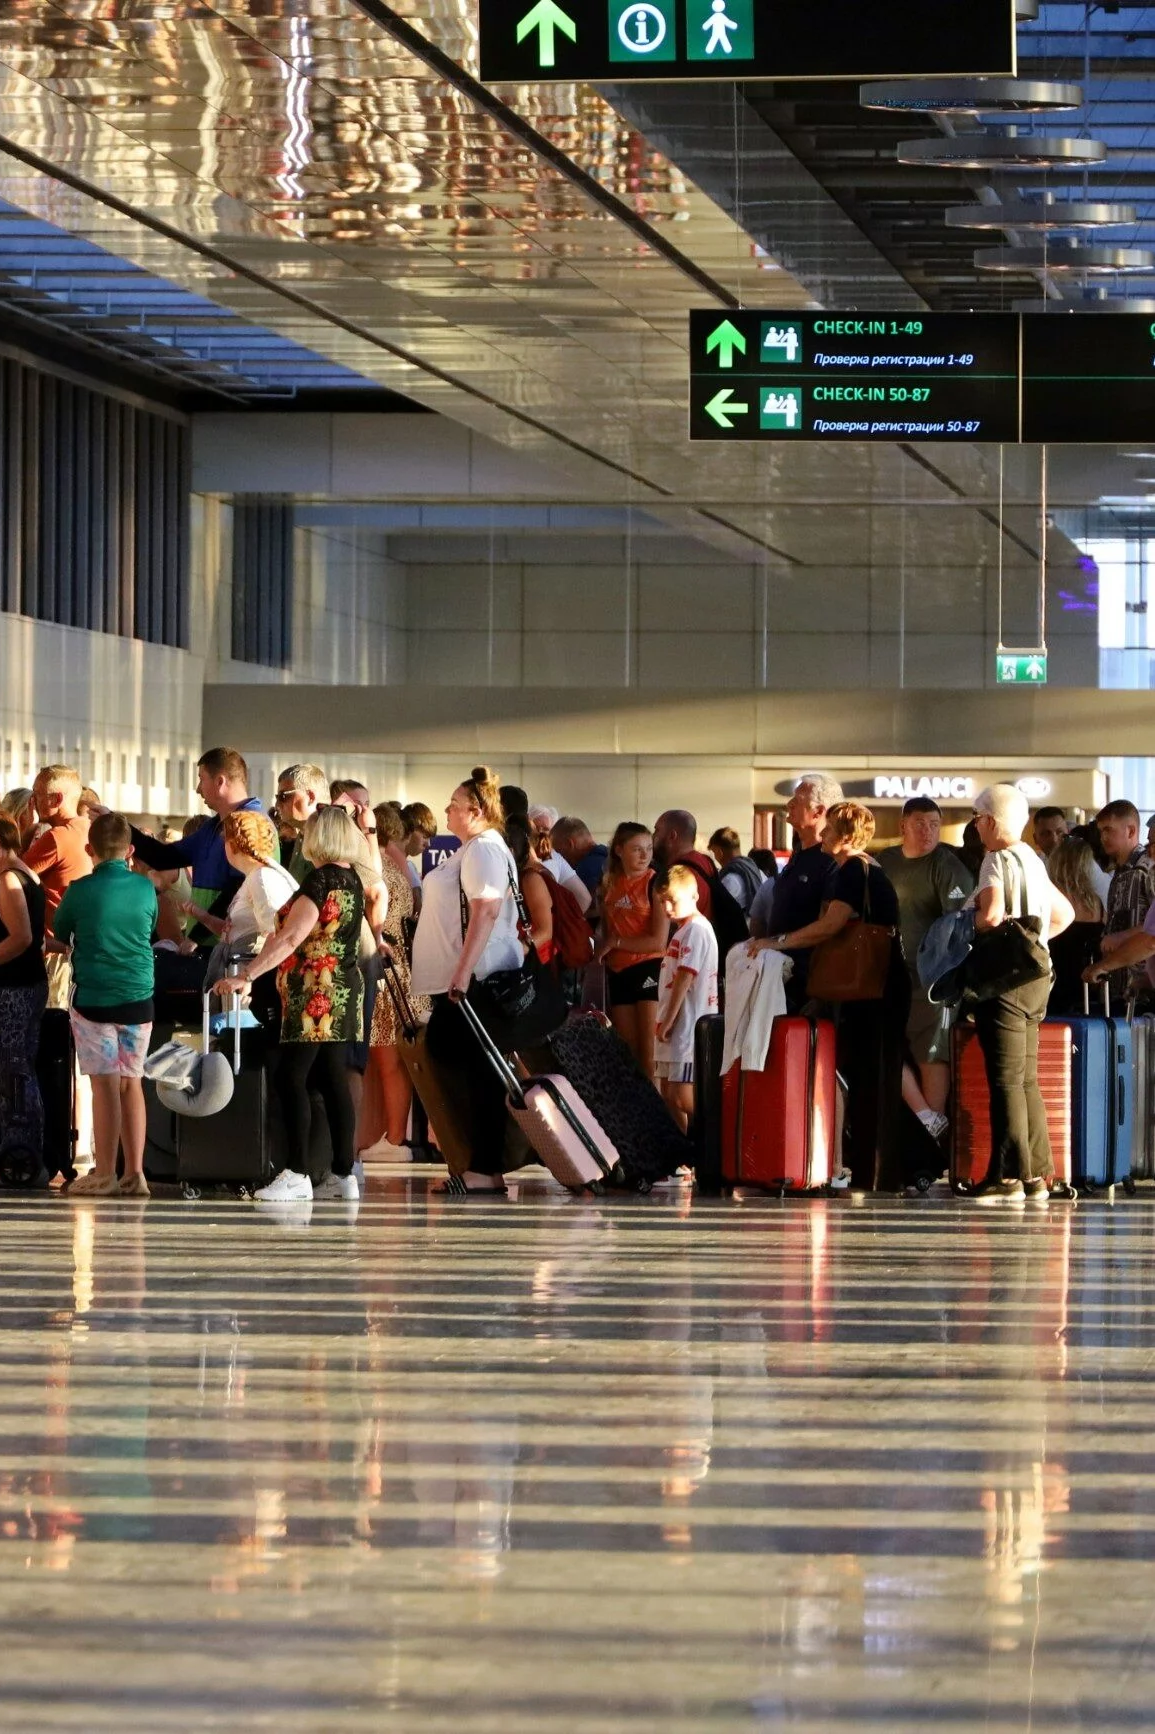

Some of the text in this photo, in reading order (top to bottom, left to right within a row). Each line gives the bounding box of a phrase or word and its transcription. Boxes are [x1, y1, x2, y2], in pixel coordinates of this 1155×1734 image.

[813, 321, 923, 335] CHECK-IN 1-49
[813, 353, 974, 367] Проверка регистрации 1-49
[813, 387, 931, 402] CHECK-IN 50-87
[813, 419, 980, 433] Проверка регистрации 50-87
[874, 776, 973, 798] PALANCI
[428, 849, 455, 866] TA
